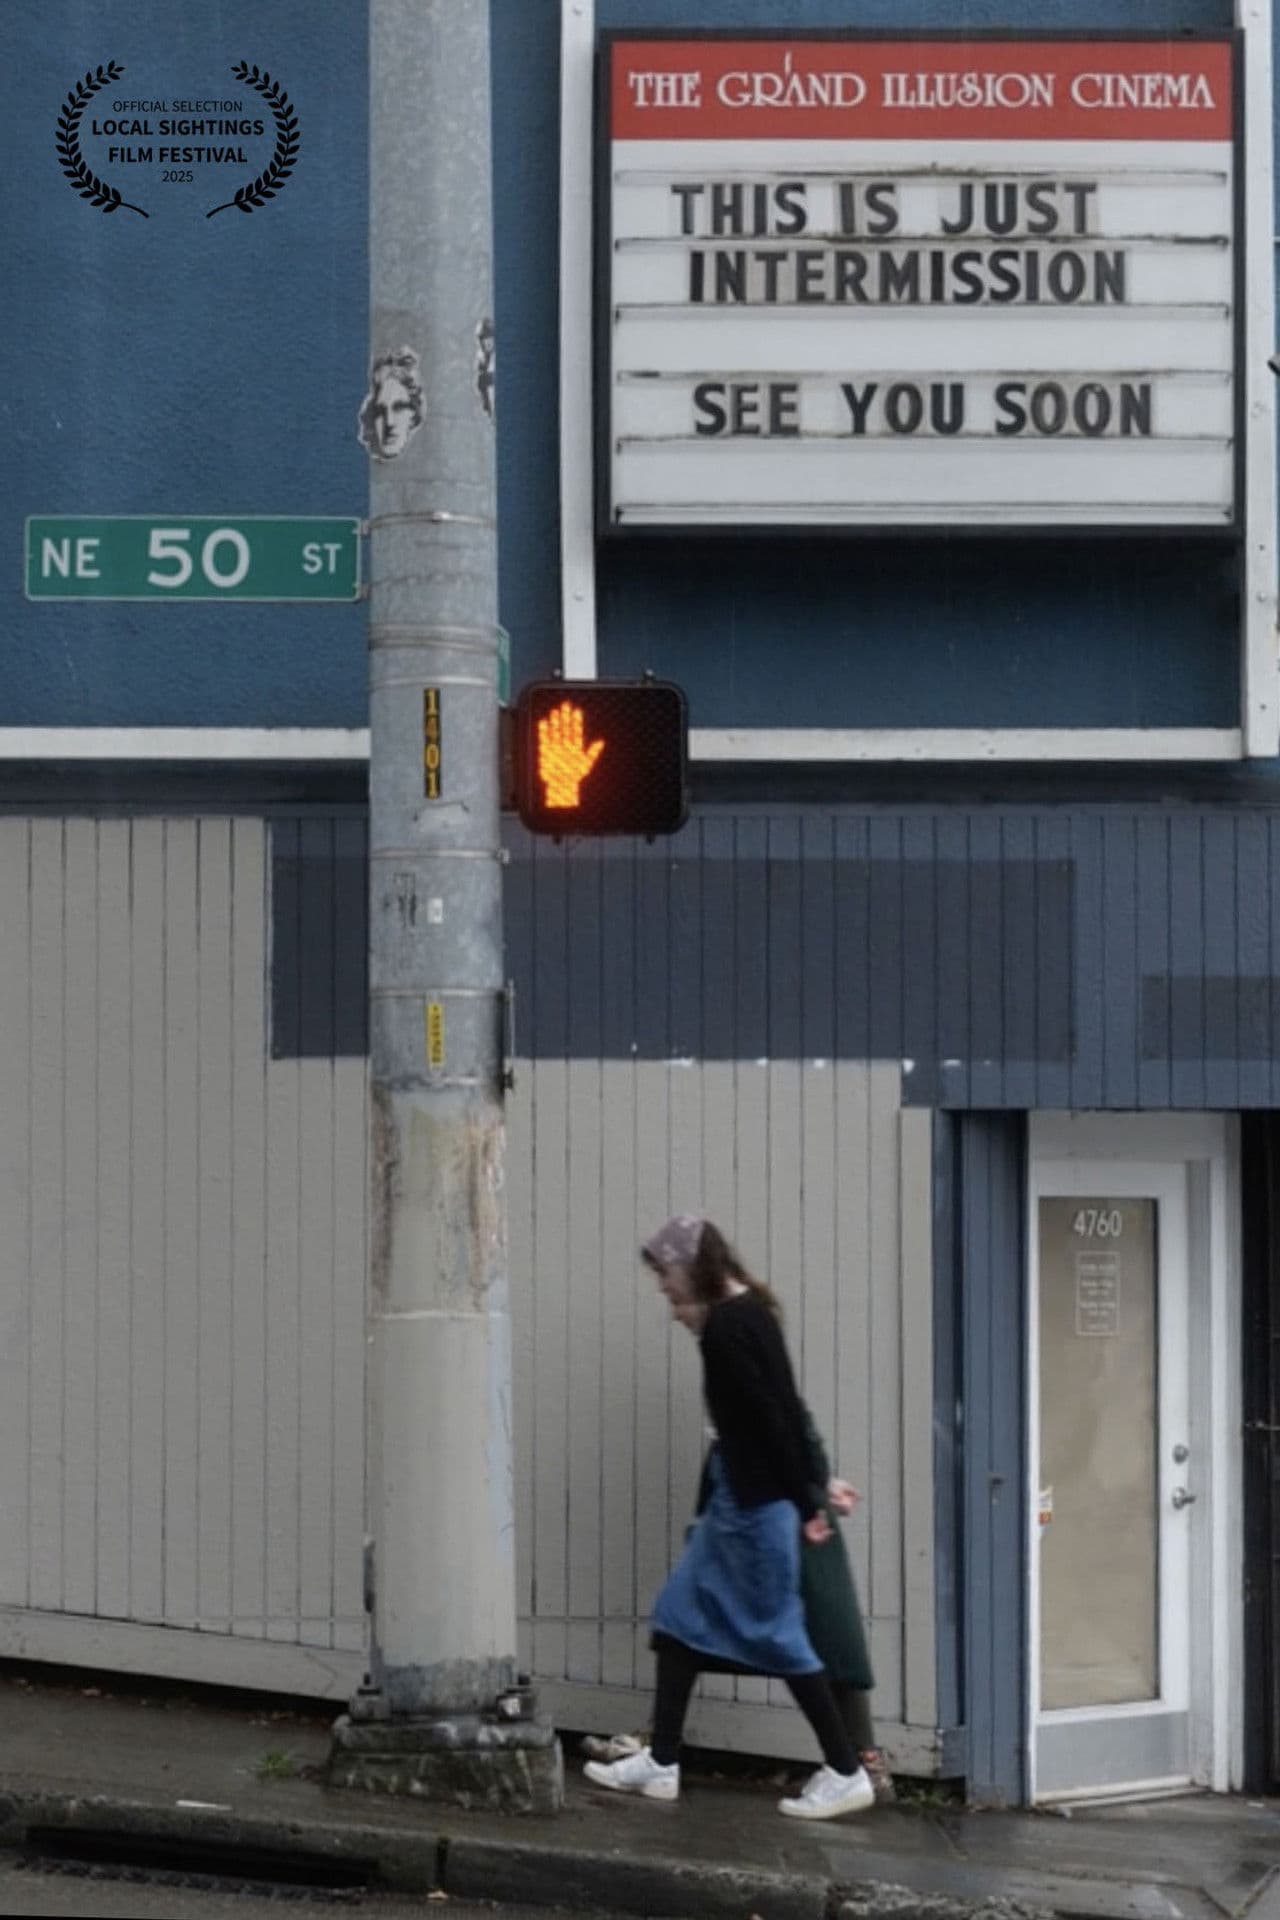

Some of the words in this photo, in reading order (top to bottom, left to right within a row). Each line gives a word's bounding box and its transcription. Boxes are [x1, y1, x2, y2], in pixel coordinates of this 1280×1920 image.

[629, 72, 700, 107] THE
[717, 53, 866, 107] GRAND
[882, 73, 1055, 106] ILLUSION
[1071, 73, 1214, 107] CINEMA
[671, 184, 807, 235] THIS
[839, 184, 898, 234] IS
[941, 183, 1098, 235] JUST
[690, 250, 1126, 303] INTERMISSION
[694, 383, 800, 435] SEE
[841, 383, 965, 435] YOU
[995, 383, 1152, 435] SOON
[41, 538, 100, 578] NE
[147, 528, 250, 587] 50
[302, 543, 342, 573] ST
[1074, 1209, 1122, 1237] 4760
